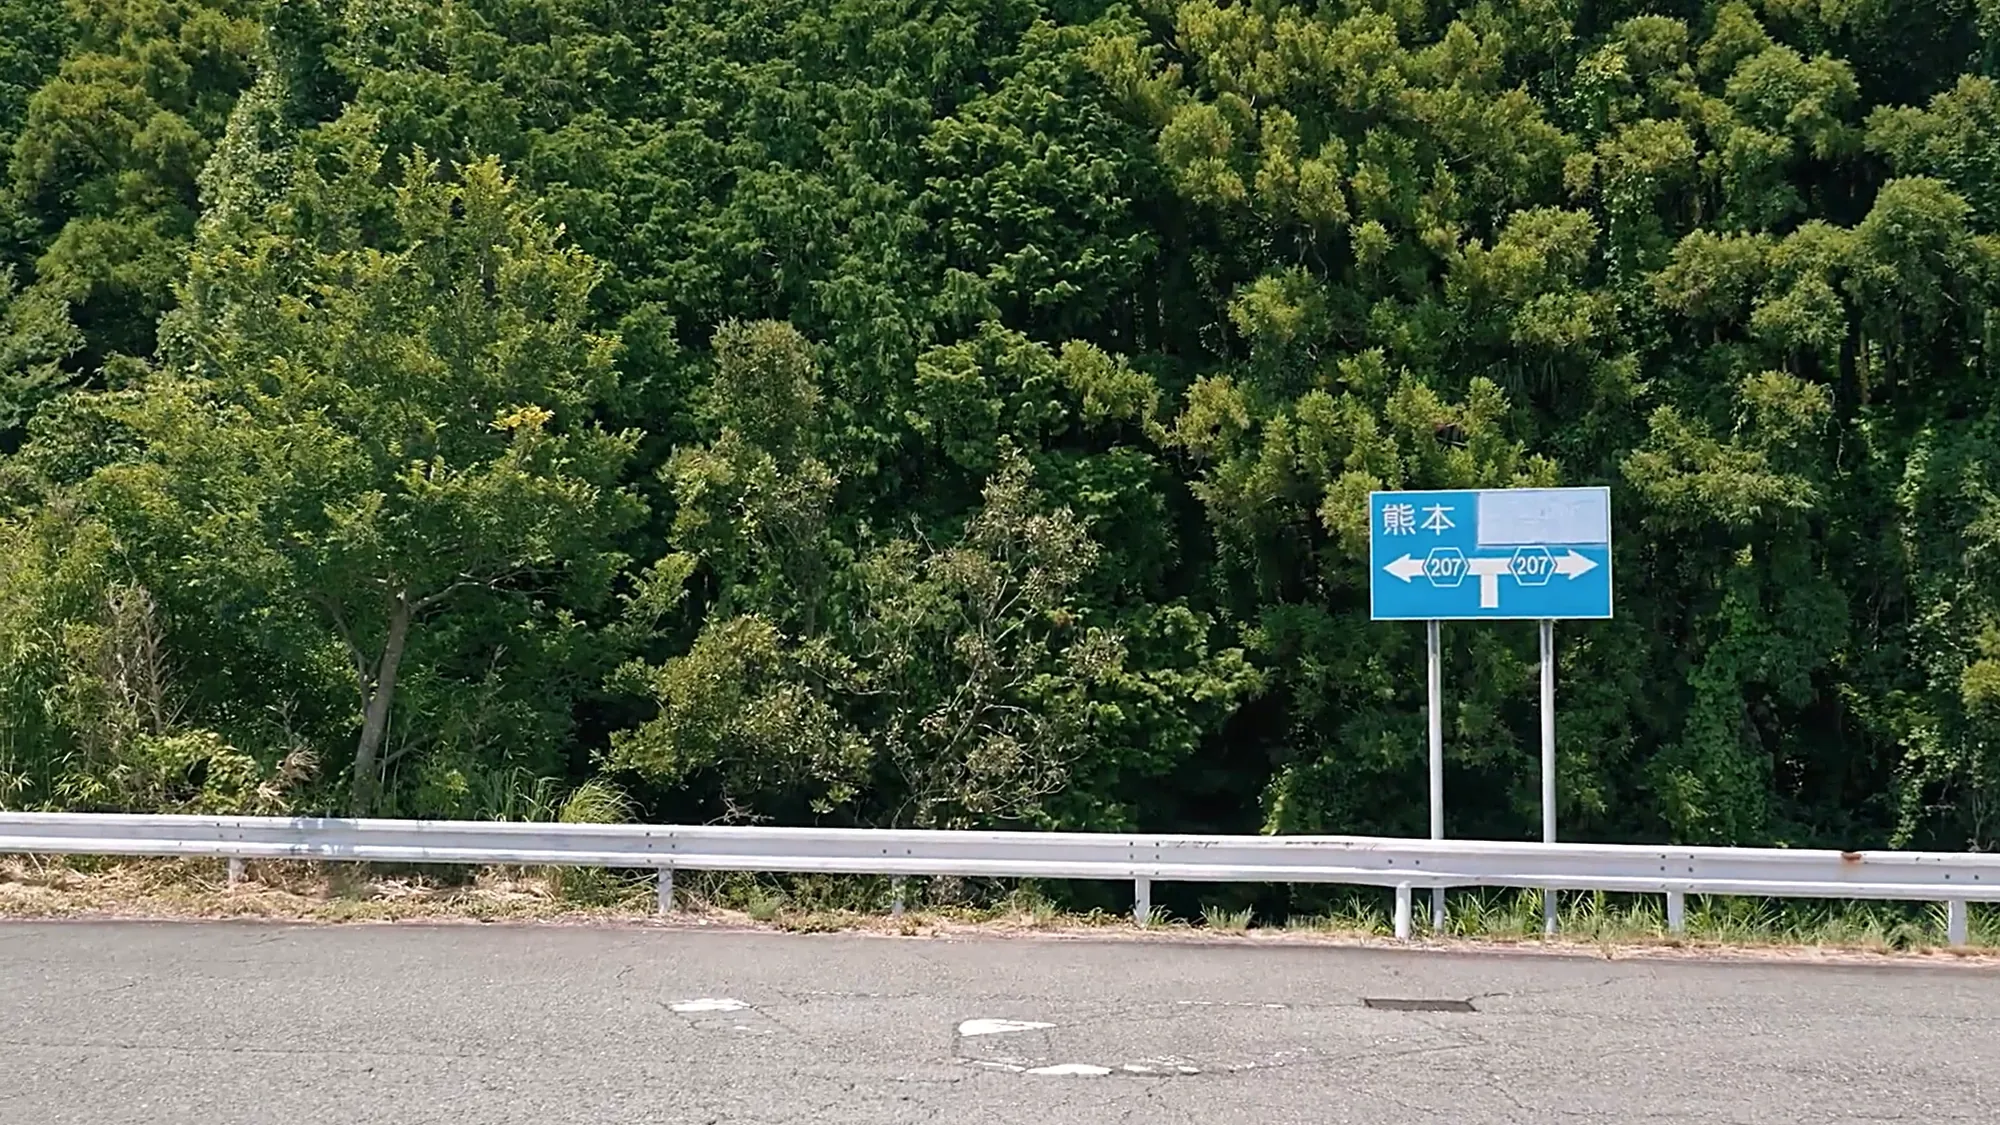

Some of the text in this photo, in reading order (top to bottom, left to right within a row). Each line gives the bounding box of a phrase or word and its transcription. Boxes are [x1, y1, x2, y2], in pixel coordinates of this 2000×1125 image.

[1381, 502, 1456, 536] 熊本
[1430, 557, 1461, 577] 207
[1516, 555, 1549, 575] 207
